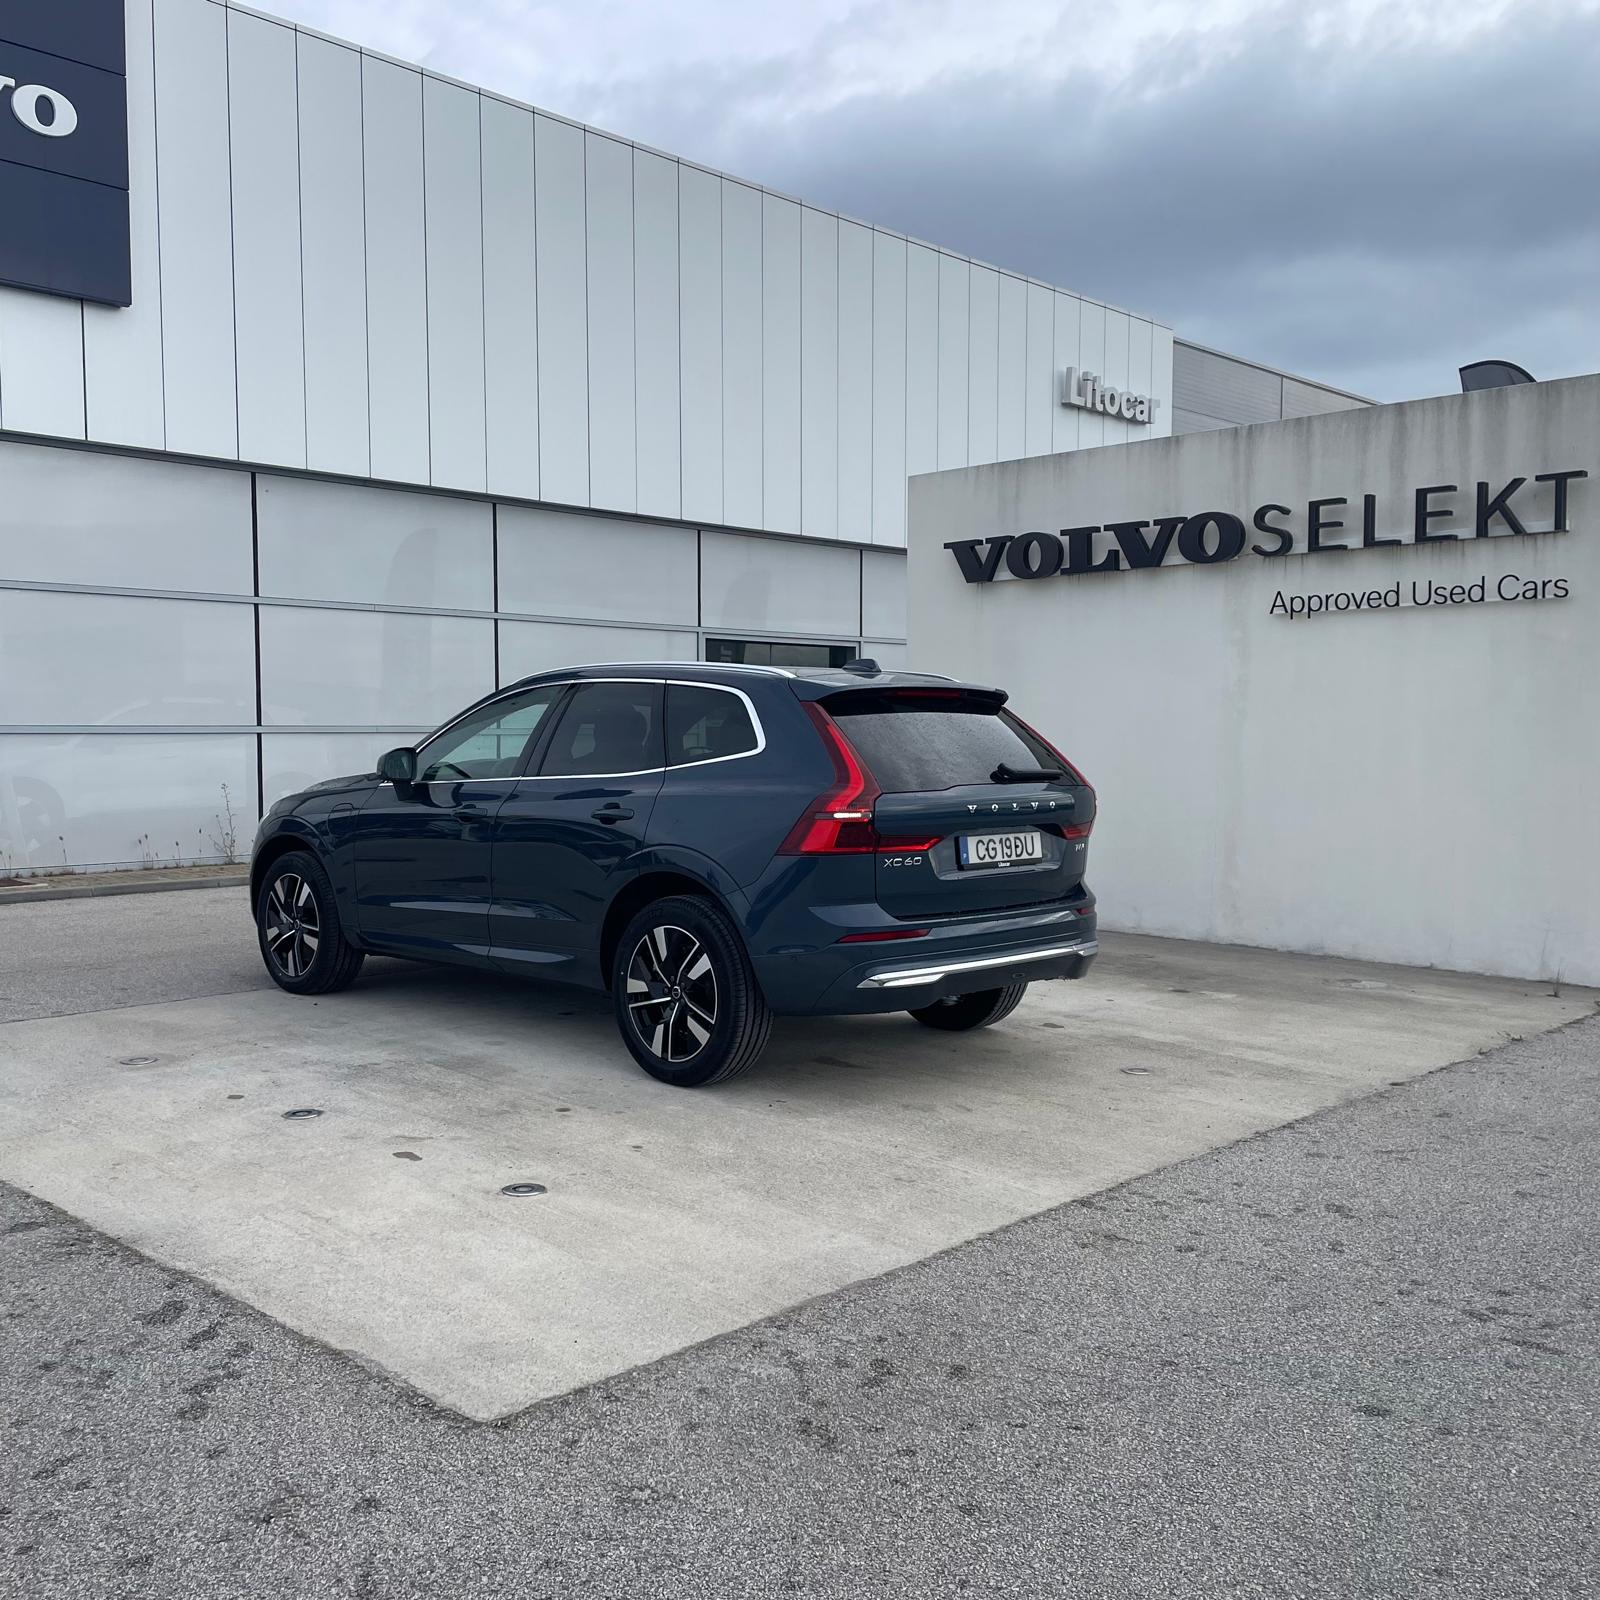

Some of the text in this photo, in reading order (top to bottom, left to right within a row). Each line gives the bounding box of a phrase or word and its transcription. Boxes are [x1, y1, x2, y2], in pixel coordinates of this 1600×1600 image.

[1269, 574, 1569, 620] Approved Used Cars
[967, 801, 1056, 814] VOLVO
[976, 835, 1035, 861] CG19DU
[883, 856, 922, 868] XC60
